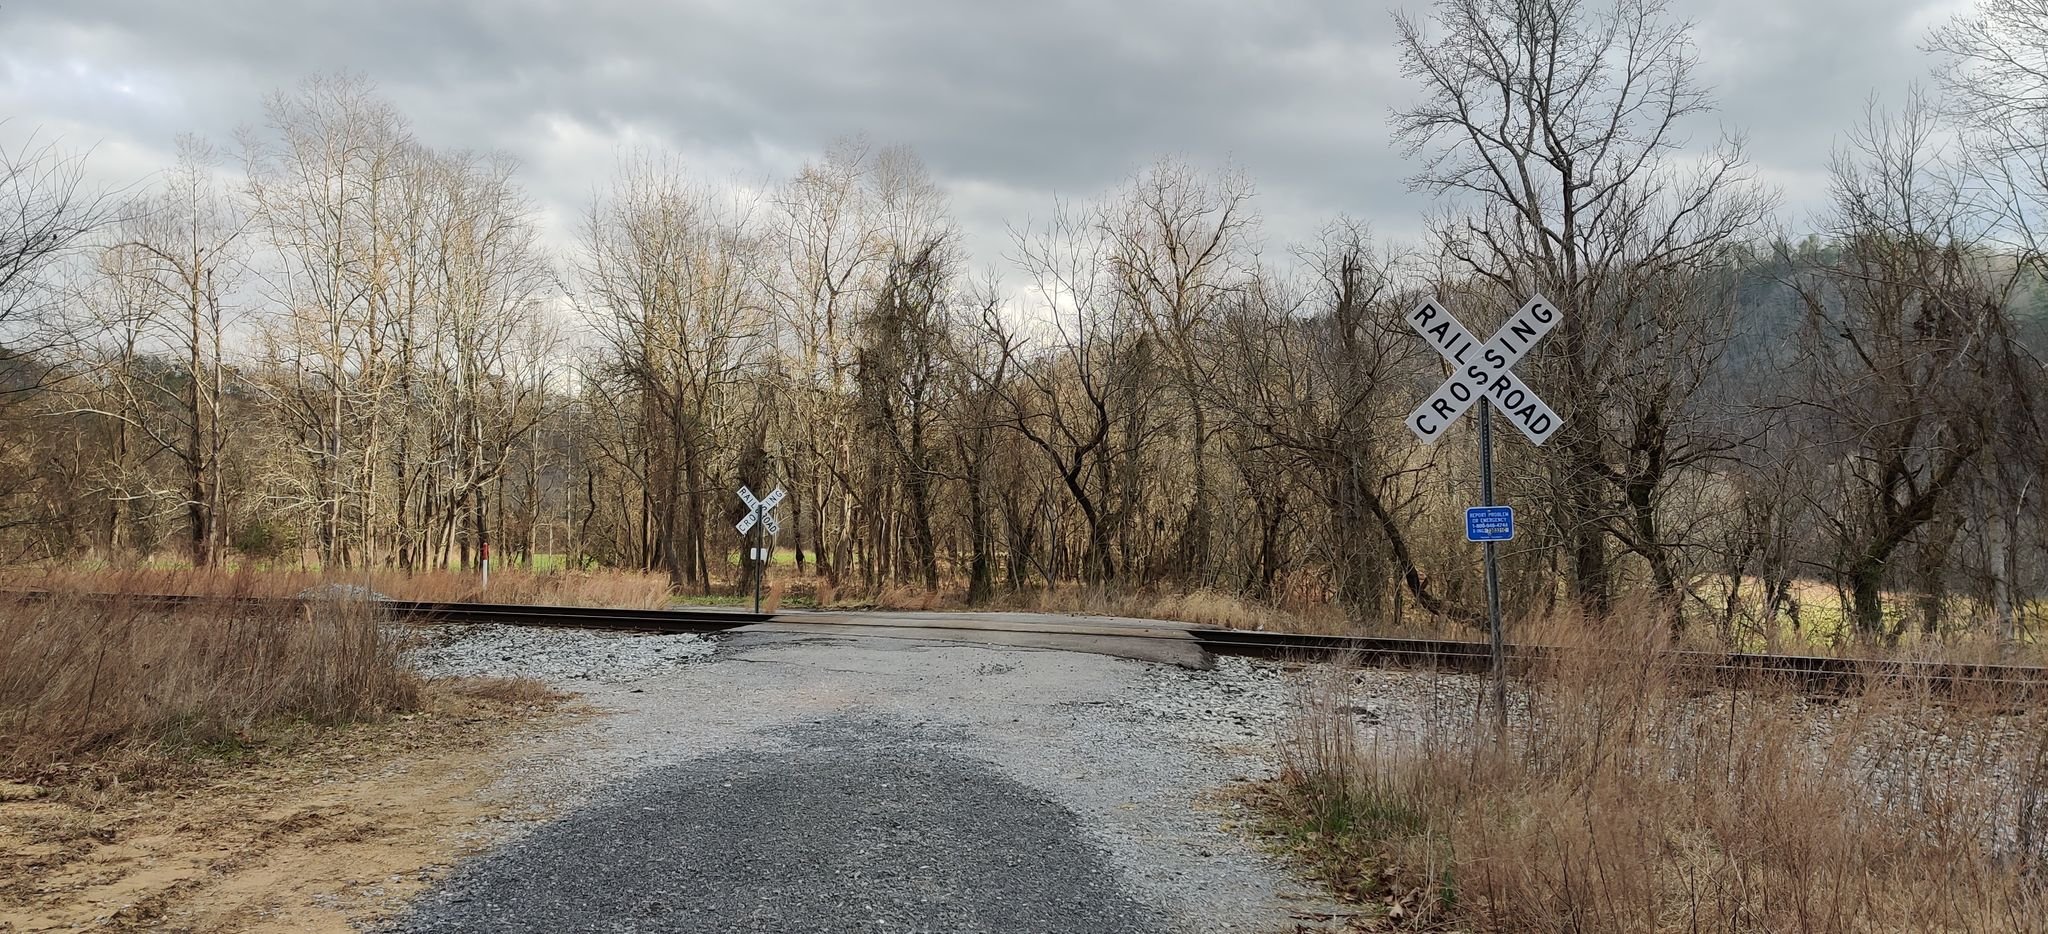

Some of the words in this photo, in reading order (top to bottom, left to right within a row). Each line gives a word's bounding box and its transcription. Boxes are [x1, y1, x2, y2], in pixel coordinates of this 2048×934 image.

[1414, 303, 1472, 365] RAIL
[1488, 375, 1551, 435] ROAD
[1416, 303, 1553, 435] CROSSING
[739, 488, 756, 508] RAIL
